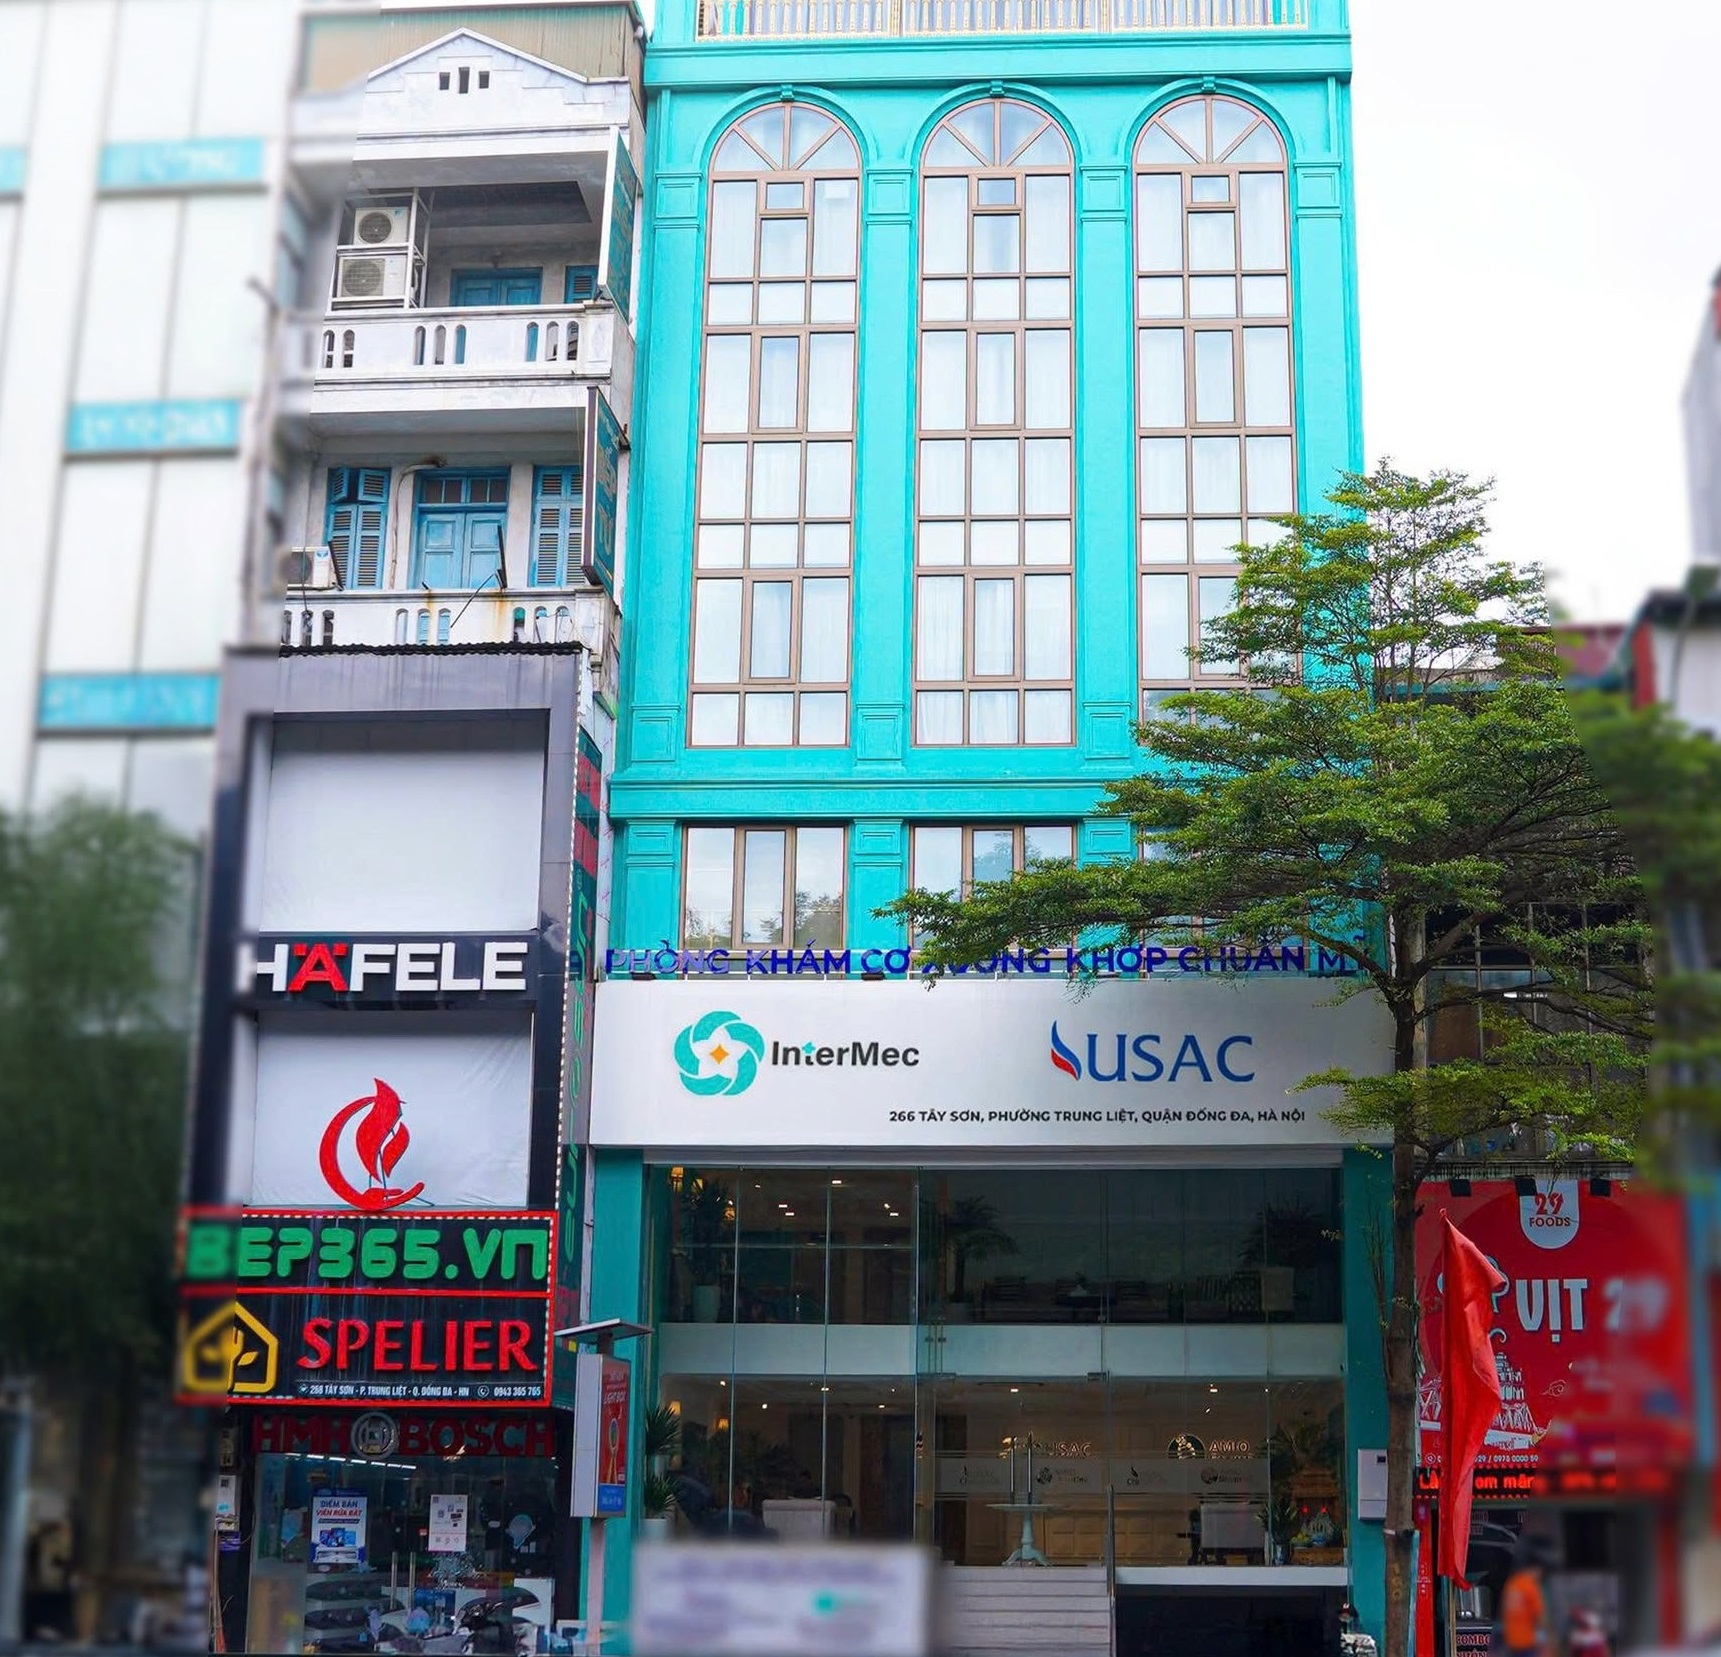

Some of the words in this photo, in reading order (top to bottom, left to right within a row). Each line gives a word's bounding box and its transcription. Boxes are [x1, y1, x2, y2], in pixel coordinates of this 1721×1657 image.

[234, 942, 528, 992] HÄFELE
[605, 939, 730, 974] PHÒNG
[746, 939, 850, 974] KHÁM
[861, 945, 911, 974] CƠ
[771, 1040, 920, 1067] InterMec
[1086, 1033, 1256, 1083] USAC
[889, 1111, 915, 1122] 266
[918, 1108, 947, 1122] TÂY
[950, 1110, 985, 1123] SƠN,
[988, 1109, 1051, 1122] PHƯỜNG
[1055, 1110, 1103, 1122] TRUNG
[1106, 1109, 1139, 1123] LIỆT,
[1141, 1109, 1182, 1124] QUẬN
[1186, 1107, 1227, 1122] ĐỐNG
[1230, 1110, 1255, 1123] ĐA,
[1257, 1108, 1278, 1121] HÀ
[1281, 1108, 1305, 1124] NỘI
[1529, 1217, 1571, 1227] FOODS
[1535, 1193, 1563, 1215] 29
[1515, 1278, 1588, 1343] VỊT
[296, 1317, 538, 1372] SPELIER
[398, 1414, 555, 1457] BOSCH
